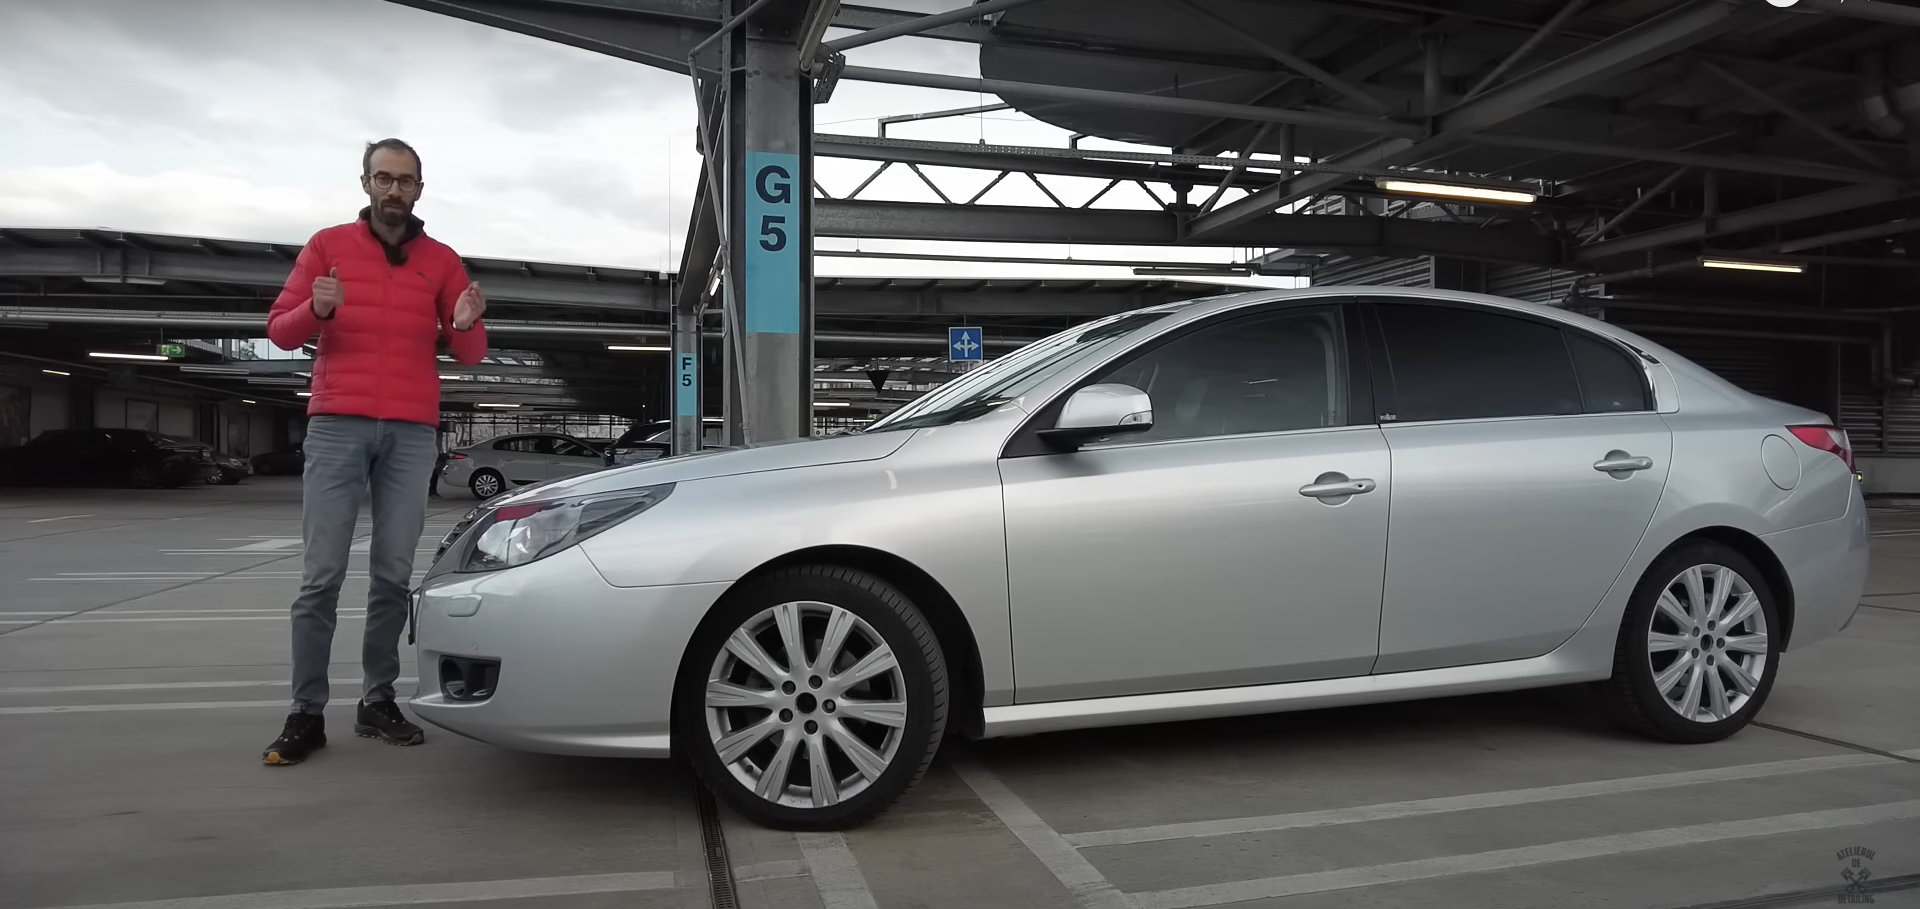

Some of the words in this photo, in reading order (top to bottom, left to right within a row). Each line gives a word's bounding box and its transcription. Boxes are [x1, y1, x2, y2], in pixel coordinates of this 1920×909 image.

[755, 165, 791, 204] G
[759, 215, 787, 252] 5
[682, 357, 692, 370] F
[682, 374, 692, 387] 5
